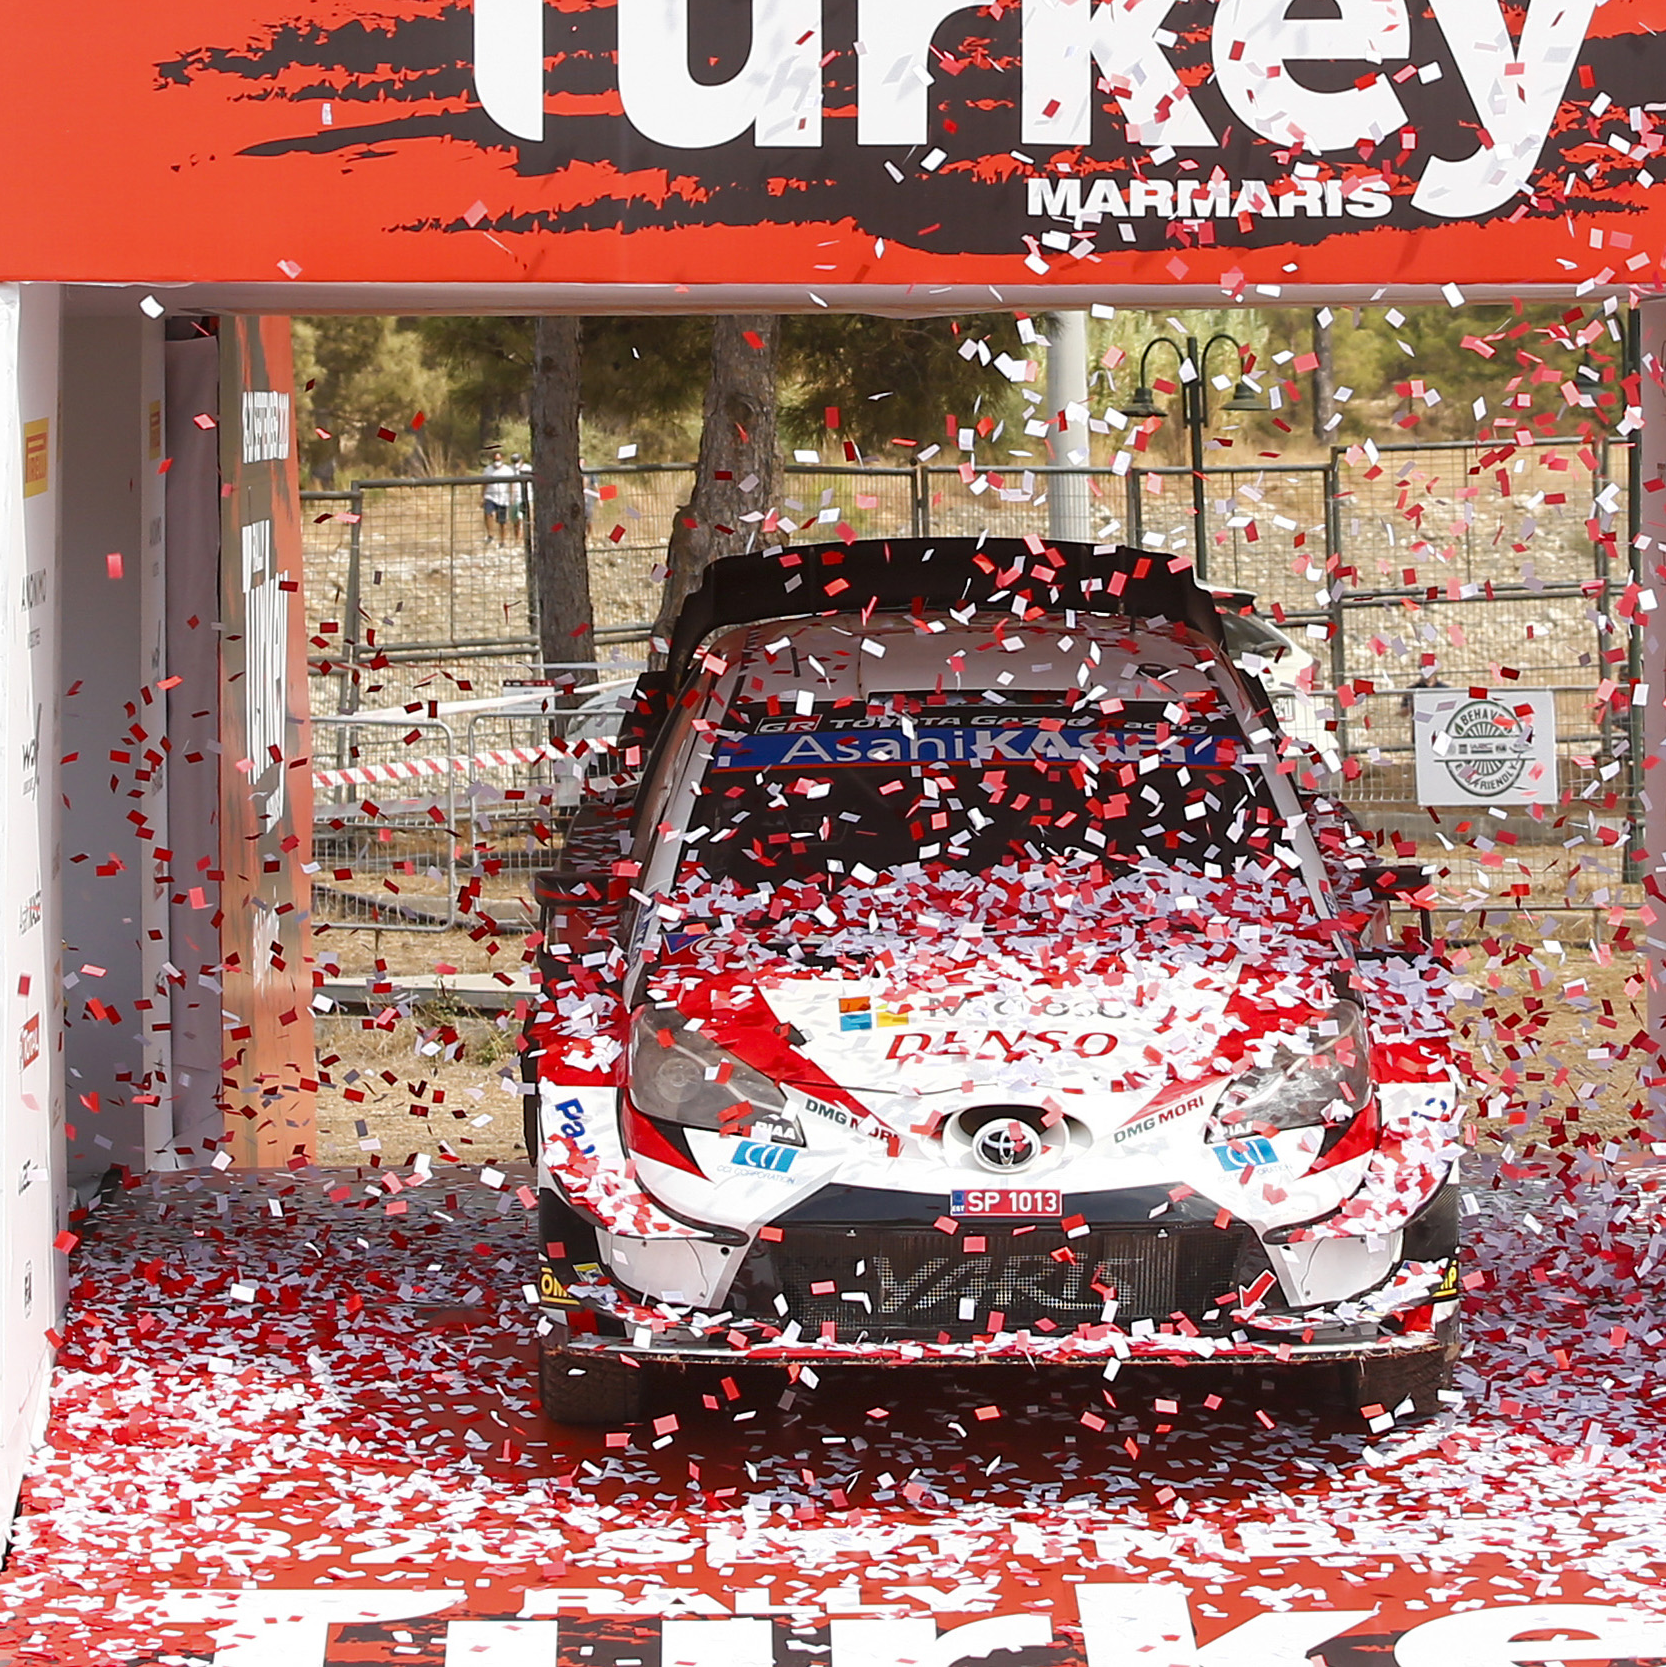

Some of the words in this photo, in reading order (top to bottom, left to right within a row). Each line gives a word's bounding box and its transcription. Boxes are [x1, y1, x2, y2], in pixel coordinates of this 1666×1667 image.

[1025, 178, 1394, 220] MARMARIS
[805, 1098, 848, 1125] DMG
[1113, 1118, 1156, 1144] DMG
[1158, 1095, 1205, 1125] MORI
[951, 1205, 965, 1213] EST
[967, 1192, 1000, 1213] SP
[1009, 1191, 1058, 1212] 1013
